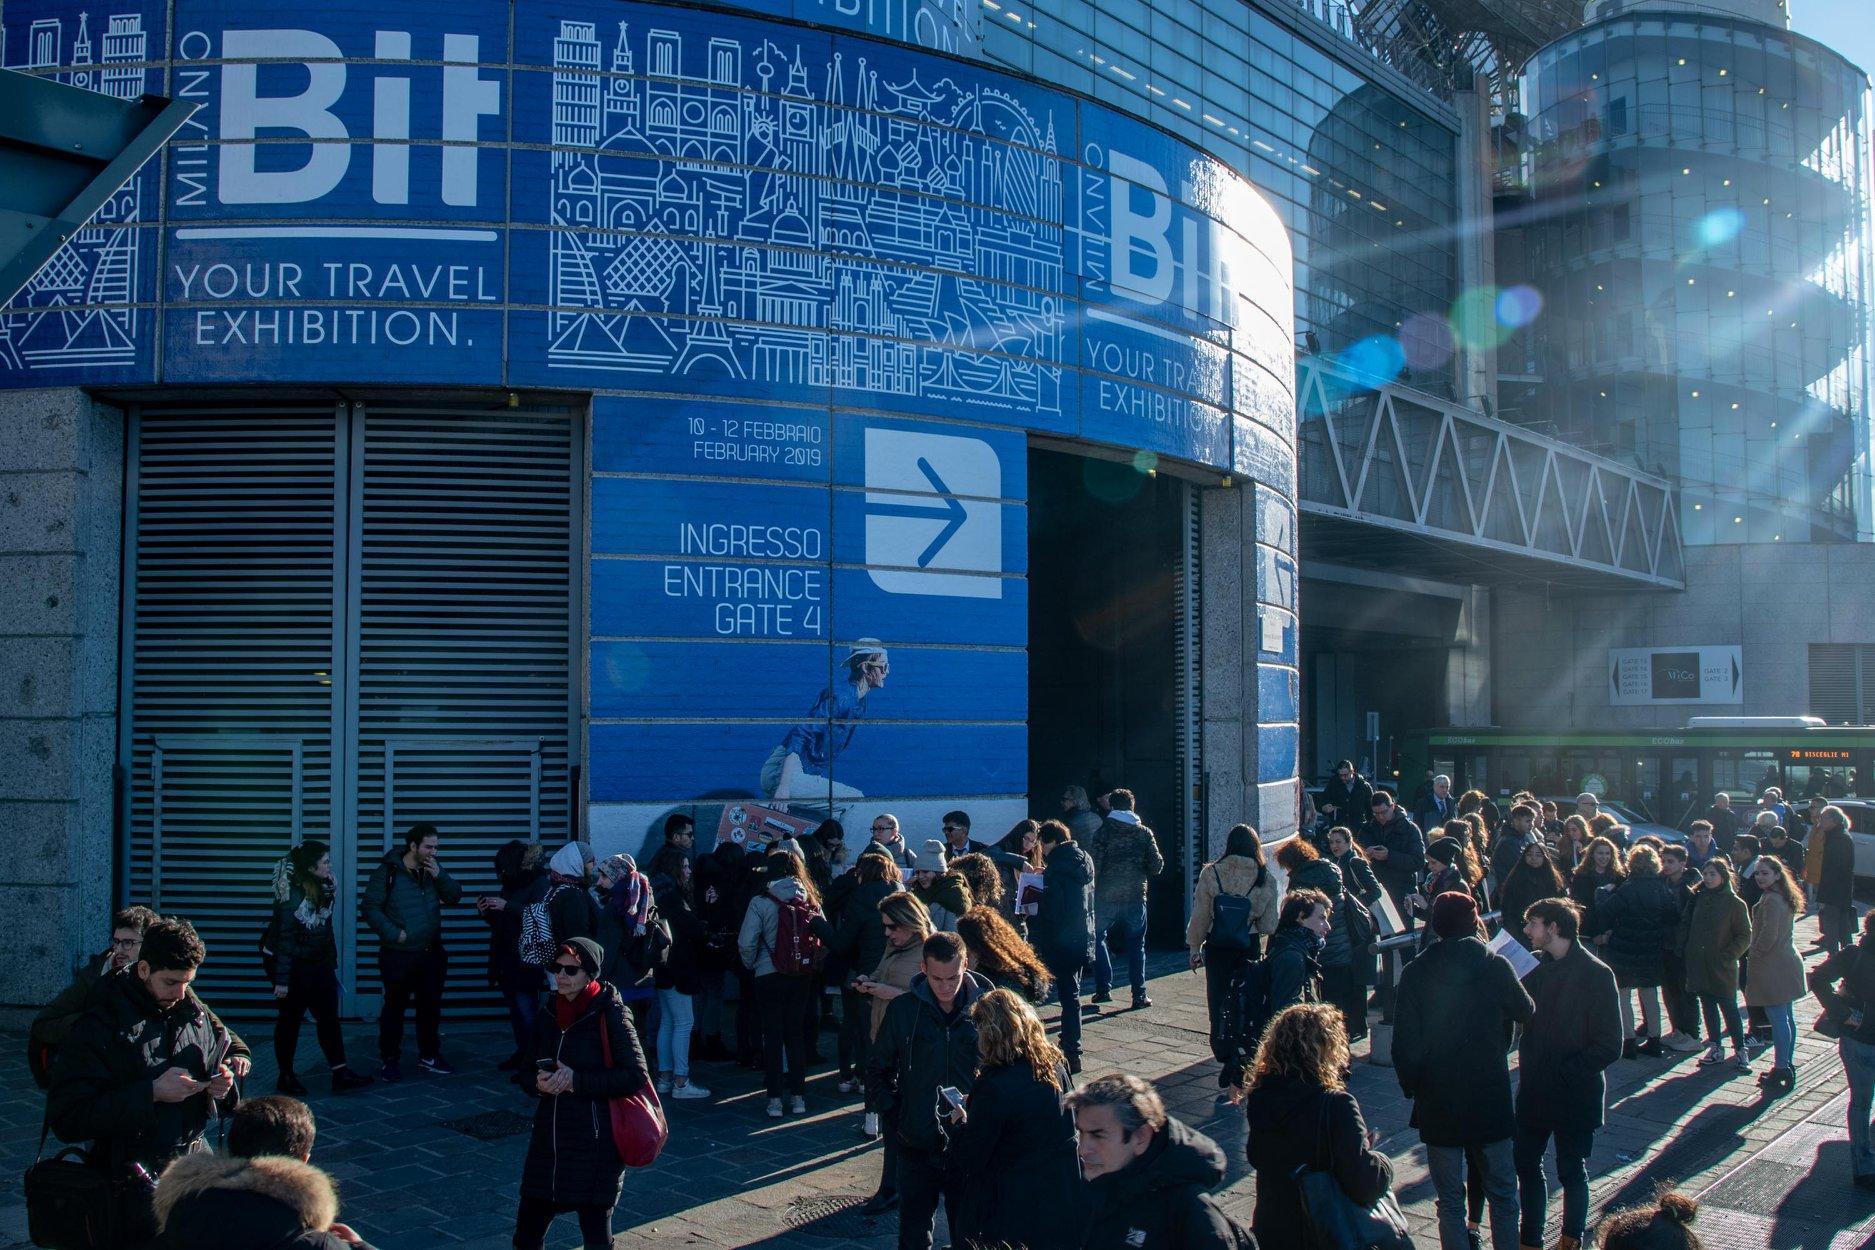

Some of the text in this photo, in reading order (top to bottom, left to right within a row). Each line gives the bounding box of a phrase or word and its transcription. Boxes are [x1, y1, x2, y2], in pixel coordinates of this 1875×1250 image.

[218, 29, 500, 206] Bit
[1085, 143, 1105, 292] MILANO
[175, 262, 496, 301] YOUR TRAVEL
[196, 310, 472, 347] EXHIBITION.
[1087, 338, 1155, 383] YOUR
[688, 417, 705, 435] 10
[723, 420, 739, 438] 12
[743, 421, 821, 444] FEBBRAIO
[694, 441, 821, 466] FEBRUARY 2019
[680, 522, 821, 559] INGRESSO
[664, 565, 821, 601] ENTRANCE
[715, 603, 821, 636] GATE 4
